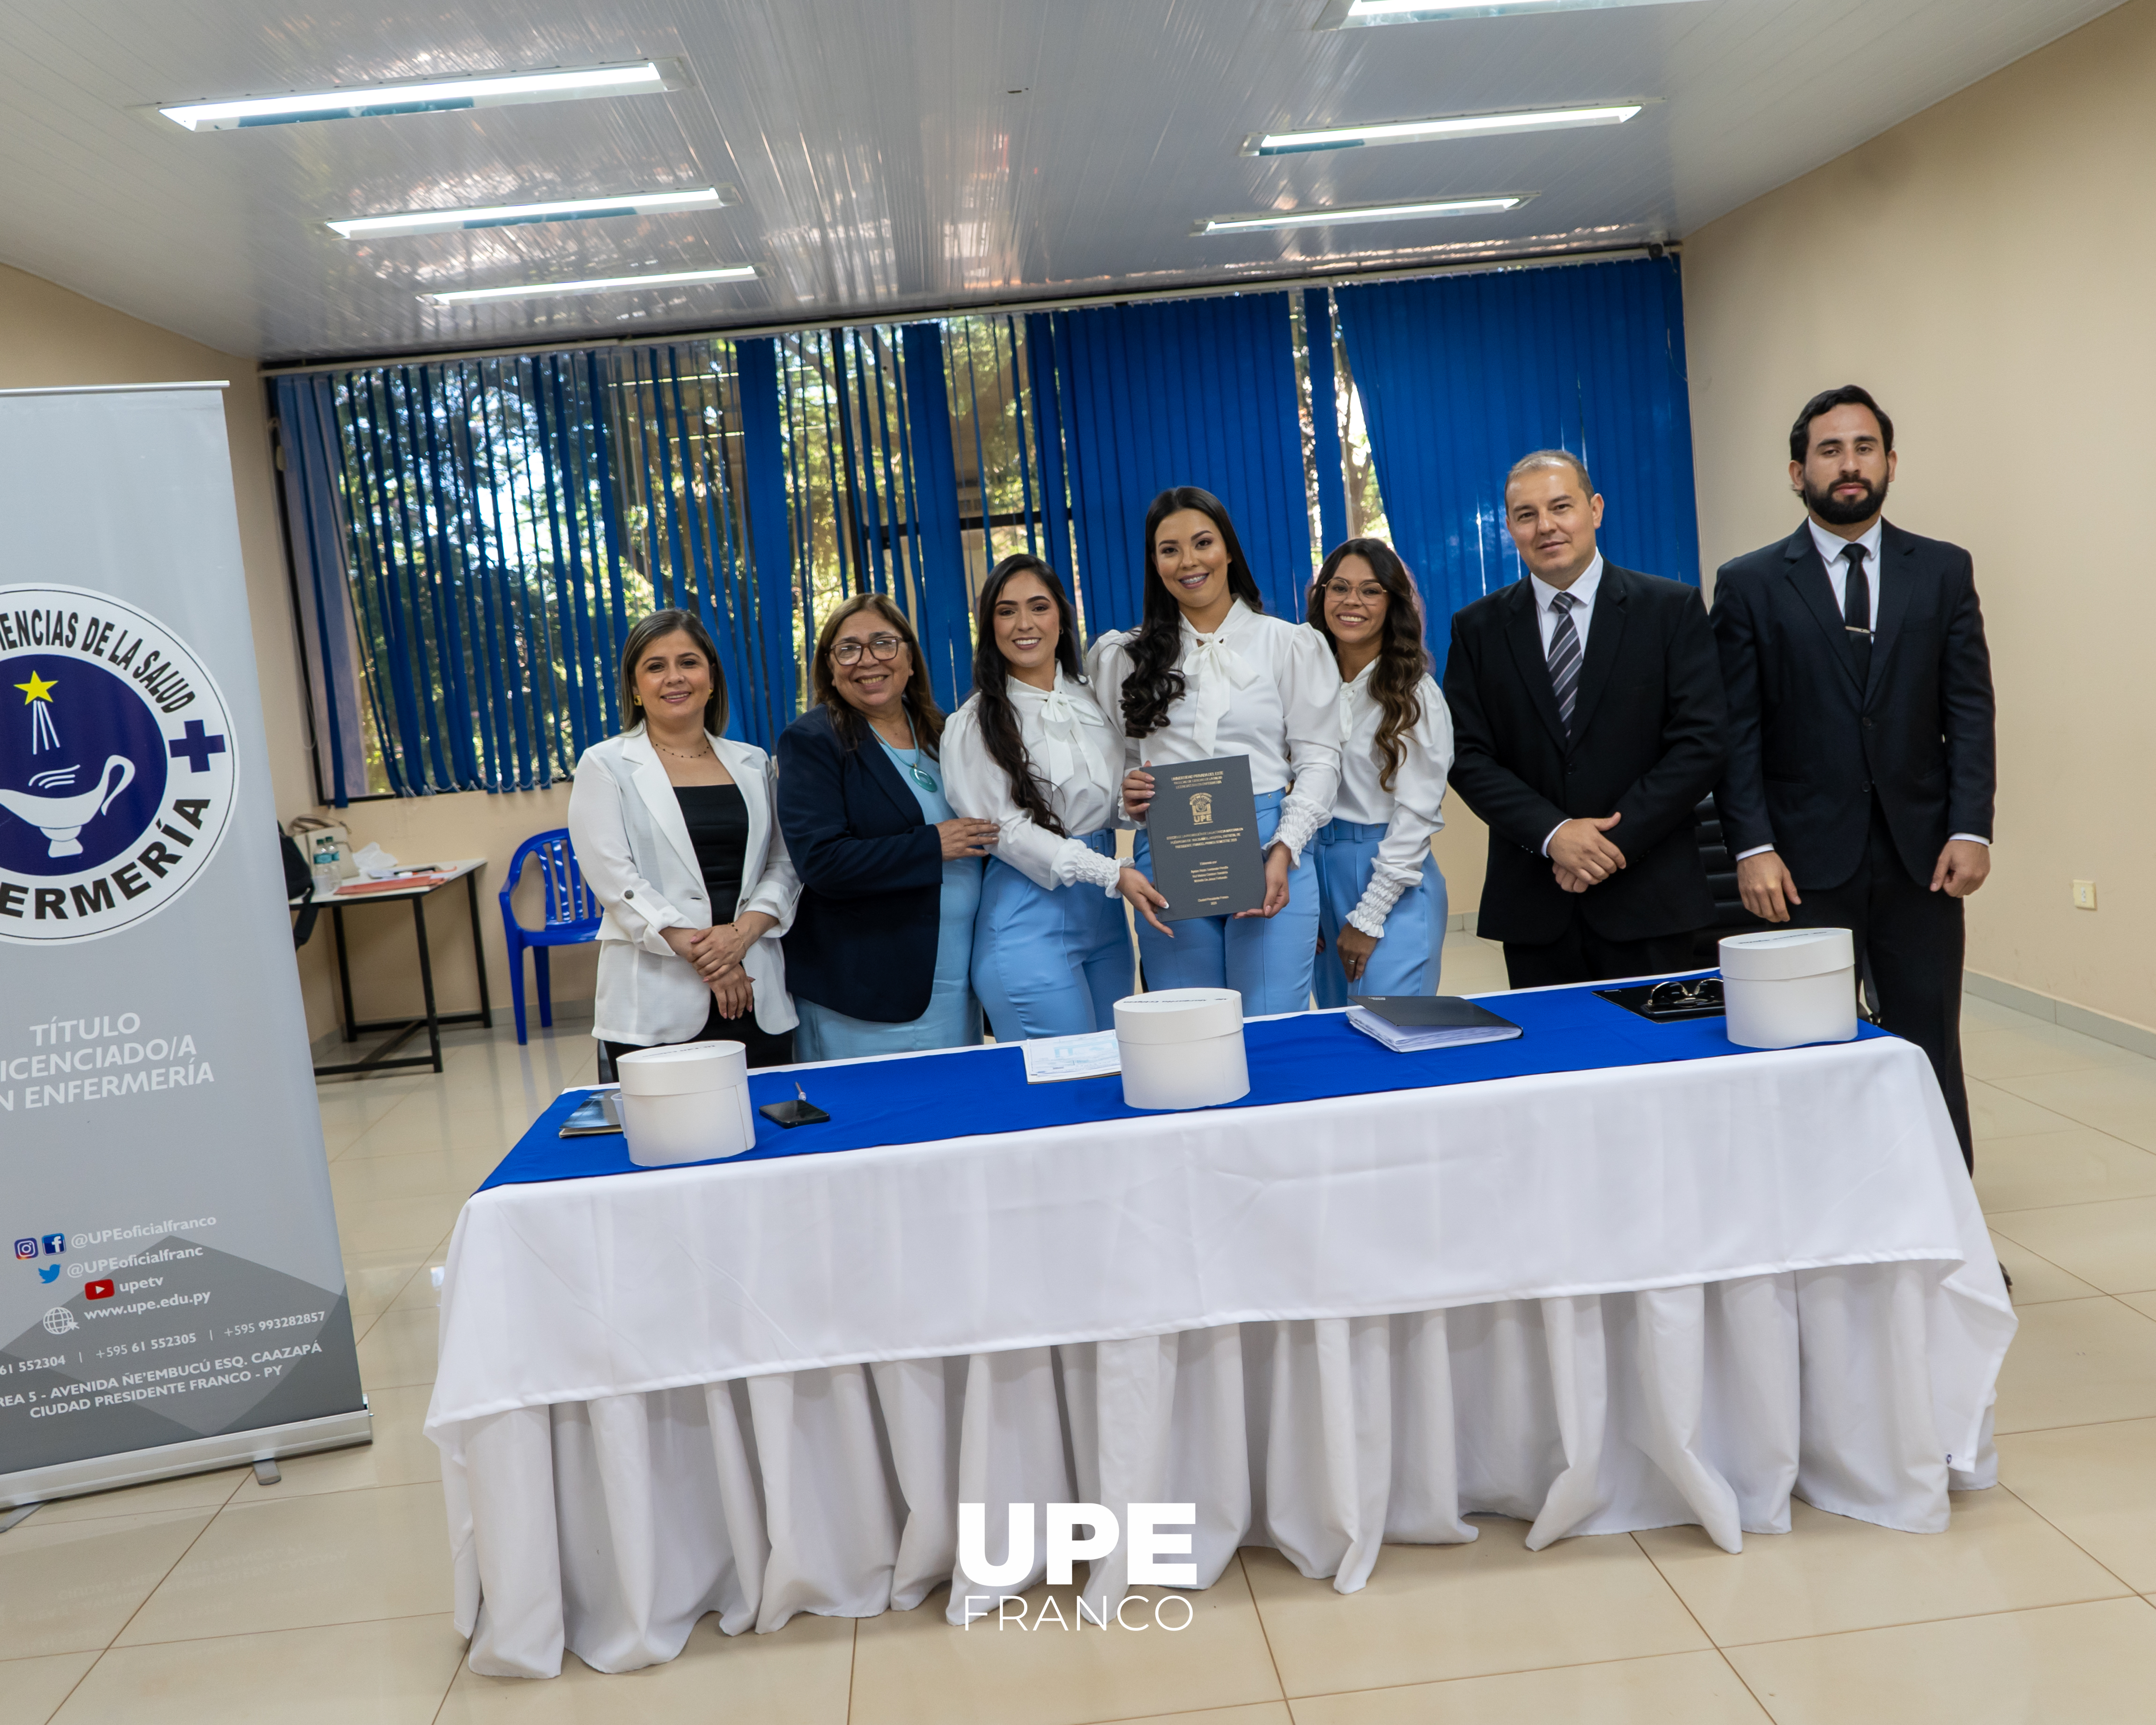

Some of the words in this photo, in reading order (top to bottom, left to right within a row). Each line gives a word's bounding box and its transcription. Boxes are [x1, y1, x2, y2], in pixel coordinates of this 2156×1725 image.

[81, 616, 115, 657] DE
[108, 629, 143, 671] LA
[133, 650, 196, 713] SALUD
[0, 799, 211, 919] ERMERÍA
[29, 1012, 140, 1046] TÍTULO
[0, 1034, 197, 1082] ICENCIADO/A
[25, 1057, 215, 1109] ENFERMERÍA
[71, 1217, 217, 1248] @UPEoficialfranco
[67, 1246, 203, 1278] @UPEoficialfranc
[119, 1276, 164, 1294] upetv
[84, 1291, 211, 1320] www.upe.edu.py
[0, 1364, 13, 1376] 61
[19, 1355, 66, 1372] 552304
[96, 1344, 128, 1358] +595
[132, 1341, 145, 1353] 61
[151, 1333, 196, 1350] 552305
[224, 1323, 255, 1337] +595
[258, 1311, 325, 1331] 993282857
[29, 1391, 37, 1403] 5
[50, 1378, 119, 1399] AVENIDA
[214, 1356, 248, 1370] ESQ.
[251, 1340, 323, 1363] CAAZAPÁ
[30, 1399, 91, 1418] CIUDAD
[95, 1382, 186, 1407] PRESIDENTE
[190, 1371, 251, 1391] FRANCO
[264, 1365, 283, 1378] PY
